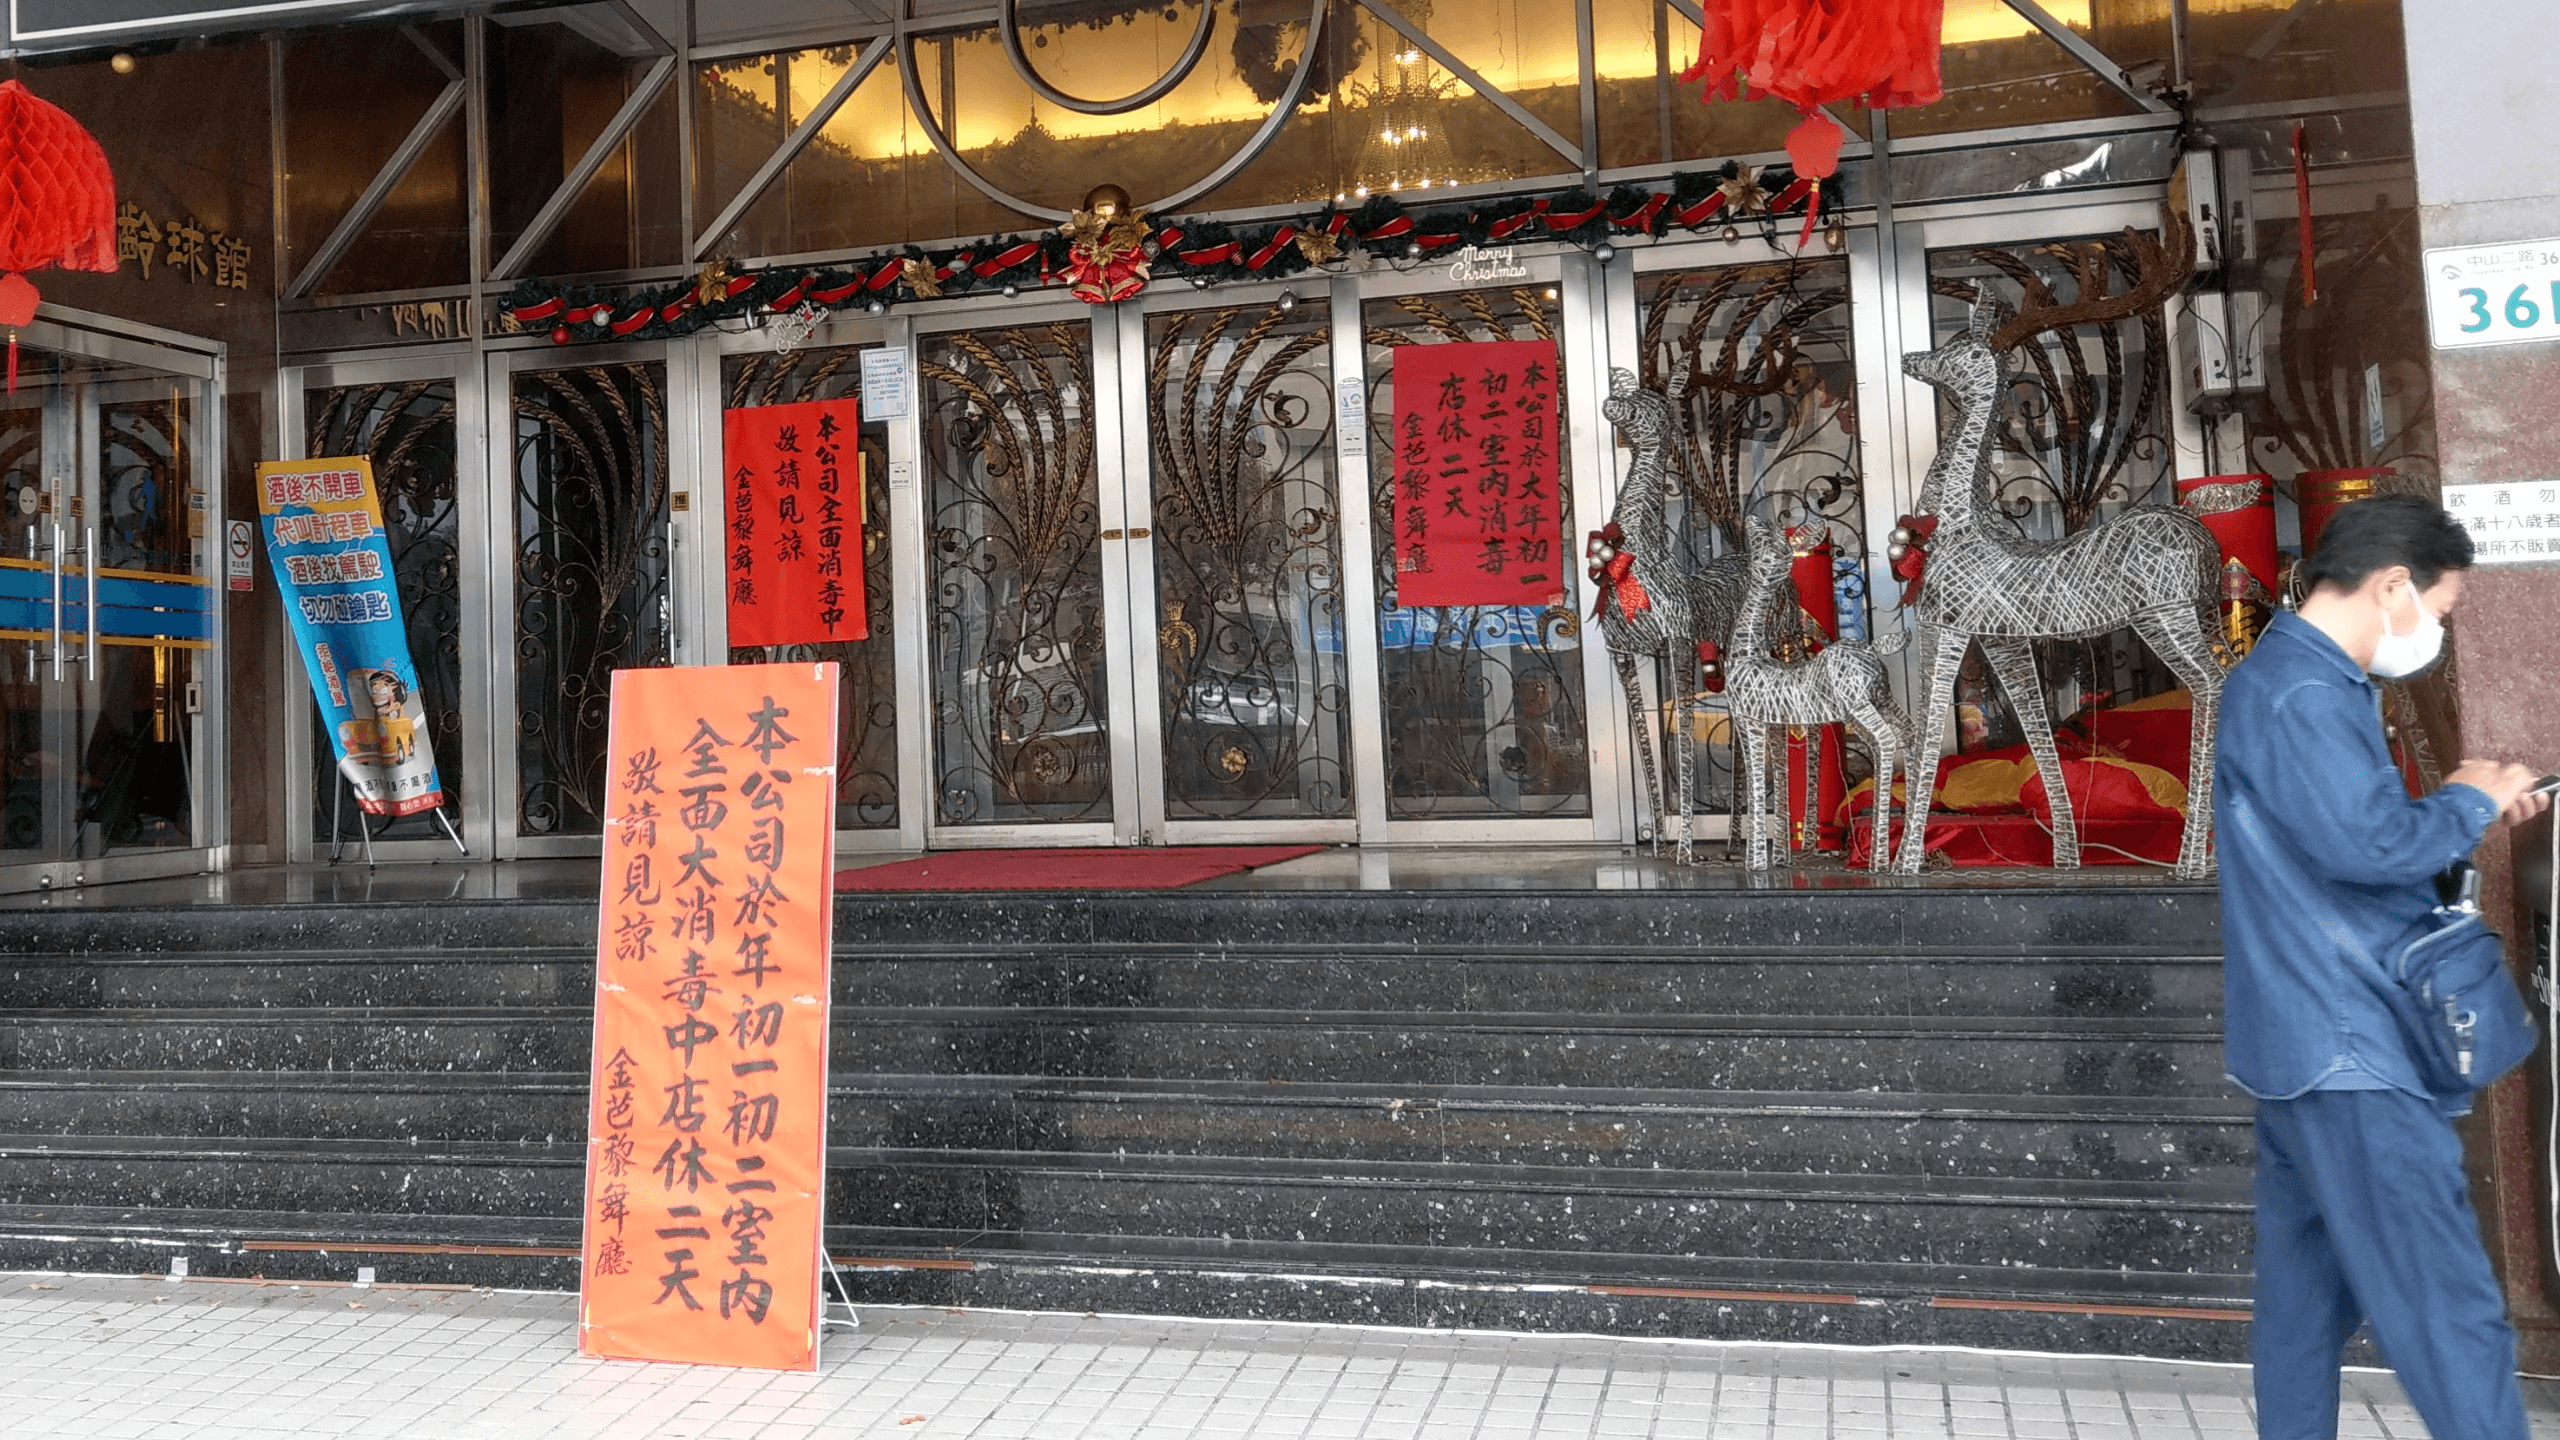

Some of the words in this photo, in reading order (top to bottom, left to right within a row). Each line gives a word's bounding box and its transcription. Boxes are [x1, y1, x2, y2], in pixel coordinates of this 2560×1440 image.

[1449, 260, 1527, 281] Christmas
[1458, 244, 1514, 265] Merry
[2466, 250, 2534, 266] 中山二路
[265, 469, 365, 506] 酒後不開車
[773, 424, 805, 562] 敬請見諒
[1437, 372, 1472, 519] 店休二天
[1514, 359, 1549, 585] 本公司於大年初一
[274, 510, 374, 545] 代叫計程車
[284, 550, 384, 585] 酒後找駕駛
[731, 464, 757, 606] 金芭黎舞廳
[814, 412, 845, 635] 本公司全面消毒中
[299, 590, 393, 624] 切勿碰鑰匙
[614, 746, 665, 962] 敬請見諒
[651, 717, 734, 1312] 全面大消毒中店休二天
[719, 695, 800, 1326] 本公司於年初一初二室內
[594, 1046, 640, 1278] 金芭黎舞廳
